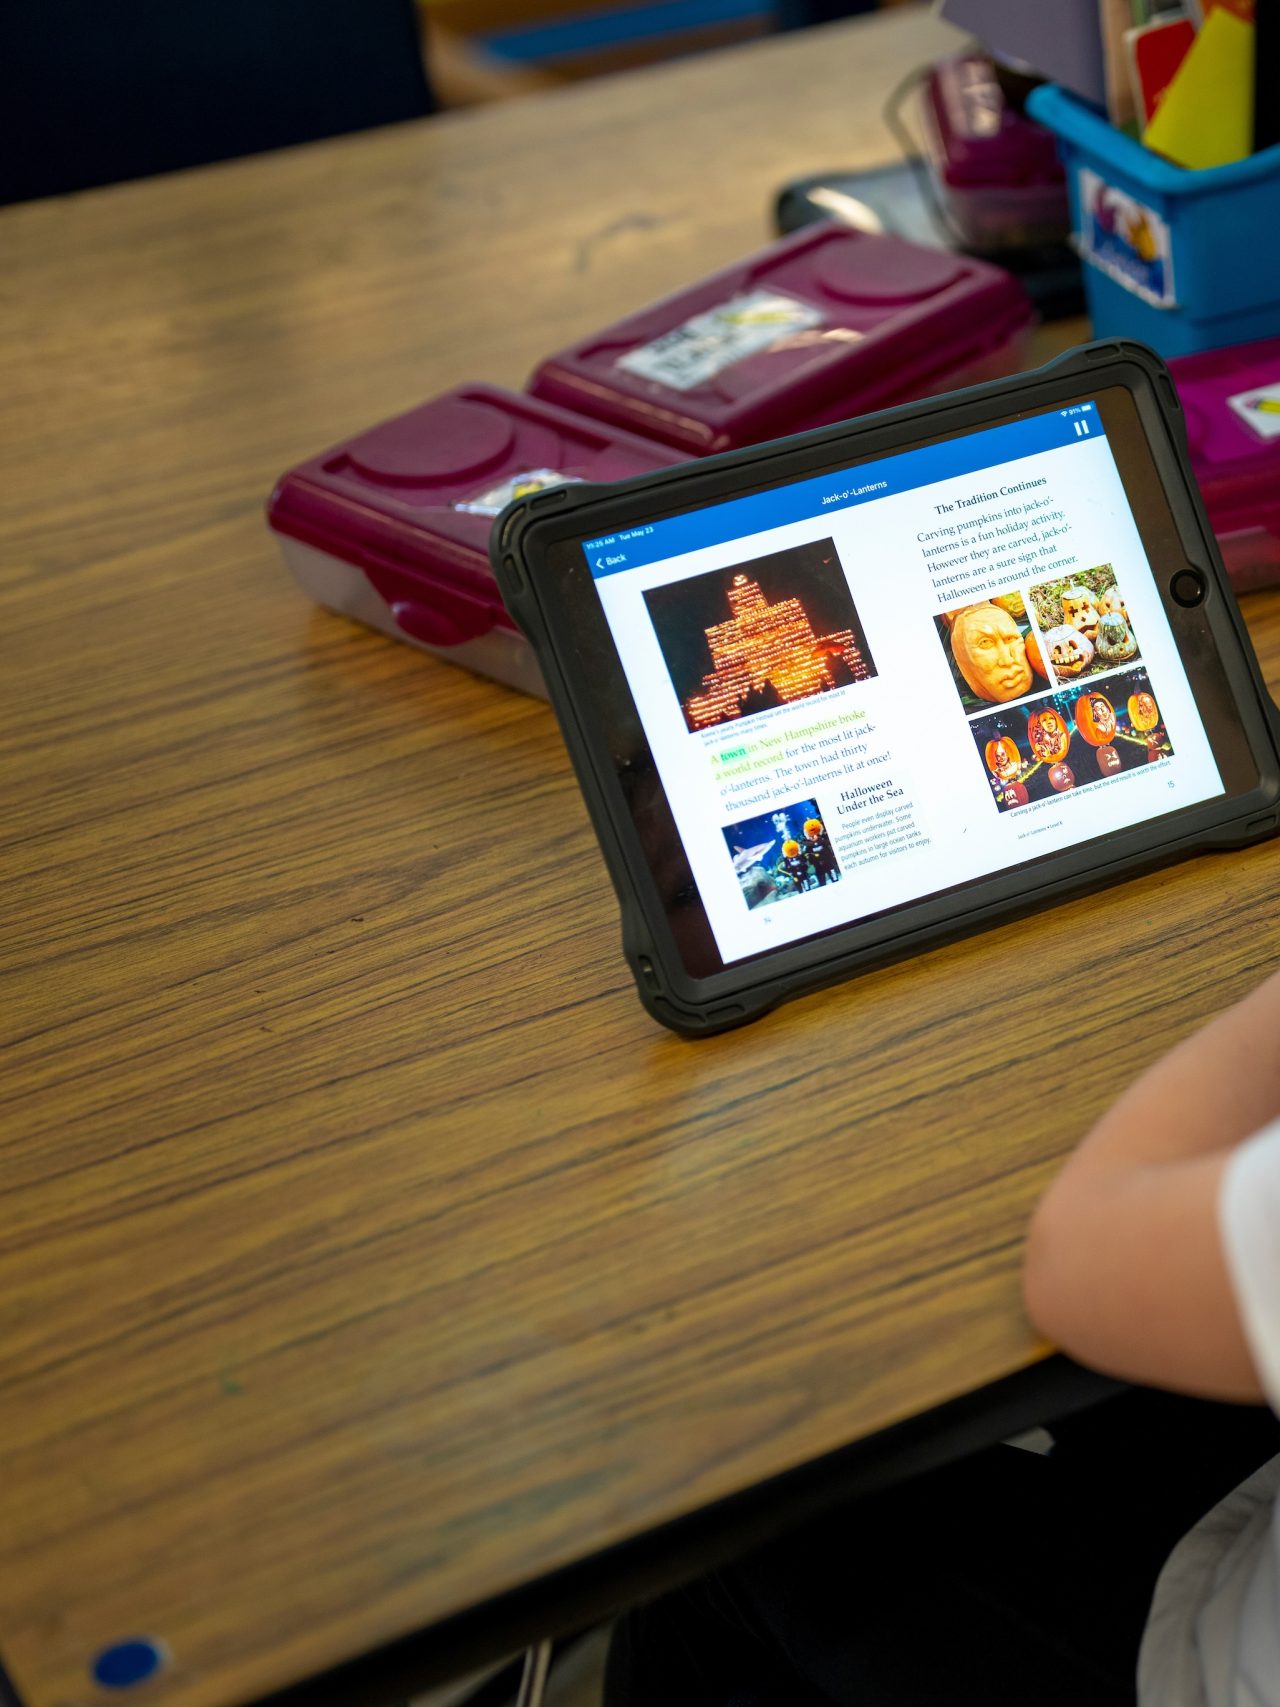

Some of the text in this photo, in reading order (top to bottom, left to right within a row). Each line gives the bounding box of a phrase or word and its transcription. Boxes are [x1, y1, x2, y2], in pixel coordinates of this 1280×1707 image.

[821, 481, 888, 505] Jack-o'-Lanterns
[933, 477, 1047, 515] The Tradition Continues
[604, 537, 615, 545] AM
[644, 526, 654, 534] 23
[917, 526, 956, 543] Carving
[956, 512, 1003, 534] pumpkins
[1004, 505, 1022, 518] into
[921, 510, 1066, 558] lanterns is a fun holiday activity.
[605, 553, 627, 566] Back
[927, 554, 968, 573] However
[970, 548, 990, 560] they
[992, 543, 1006, 554] are
[1008, 532, 1041, 549] carved,
[931, 544, 1057, 588] lanterns are a sure sign that
[937, 555, 1079, 603] Halloween is around the corner.
[791, 702, 805, 711] world
[805, 697, 821, 708] record
[828, 691, 840, 700] most
[711, 710, 866, 765] A town in New Hampshire broke
[722, 760, 752, 777] world
[753, 751, 784, 769] record
[785, 748, 799, 759] for
[800, 743, 817, 753] the
[818, 733, 842, 748] most
[842, 730, 854, 740] lit
[854, 723, 876, 739] jack-
[775, 767, 793, 779] The
[794, 759, 820, 773] town
[820, 750, 840, 764] had
[840, 743, 868, 758] thirty
[725, 789, 771, 812] thousand
[843, 763, 855, 774] lit
[855, 760, 865, 770] at
[866, 751, 892, 766] once!
[840, 779, 893, 802] Halloween
[1010, 807, 1029, 818] Carving
[1071, 789, 1082, 797] take
[1110, 777, 1119, 785] end
[1119, 773, 1132, 782] result
[1136, 767, 1150, 776] worth
[1167, 779, 1175, 788] 15
[836, 788, 904, 815] Under the Sea
[841, 801, 914, 831] People even display carved
[834, 813, 912, 844] pumpkins underwater. Some
[838, 821, 915, 852] aquarium workers put carved
[841, 847, 868, 862] pumpkins
[873, 840, 889, 850] large
[889, 835, 906, 845] ocean
[905, 830, 922, 840] tanks
[844, 861, 858, 870] each
[858, 854, 880, 866] autumn
[879, 850, 888, 858] for
[888, 844, 908, 856] visitors
[915, 837, 932, 847] enjoy.
